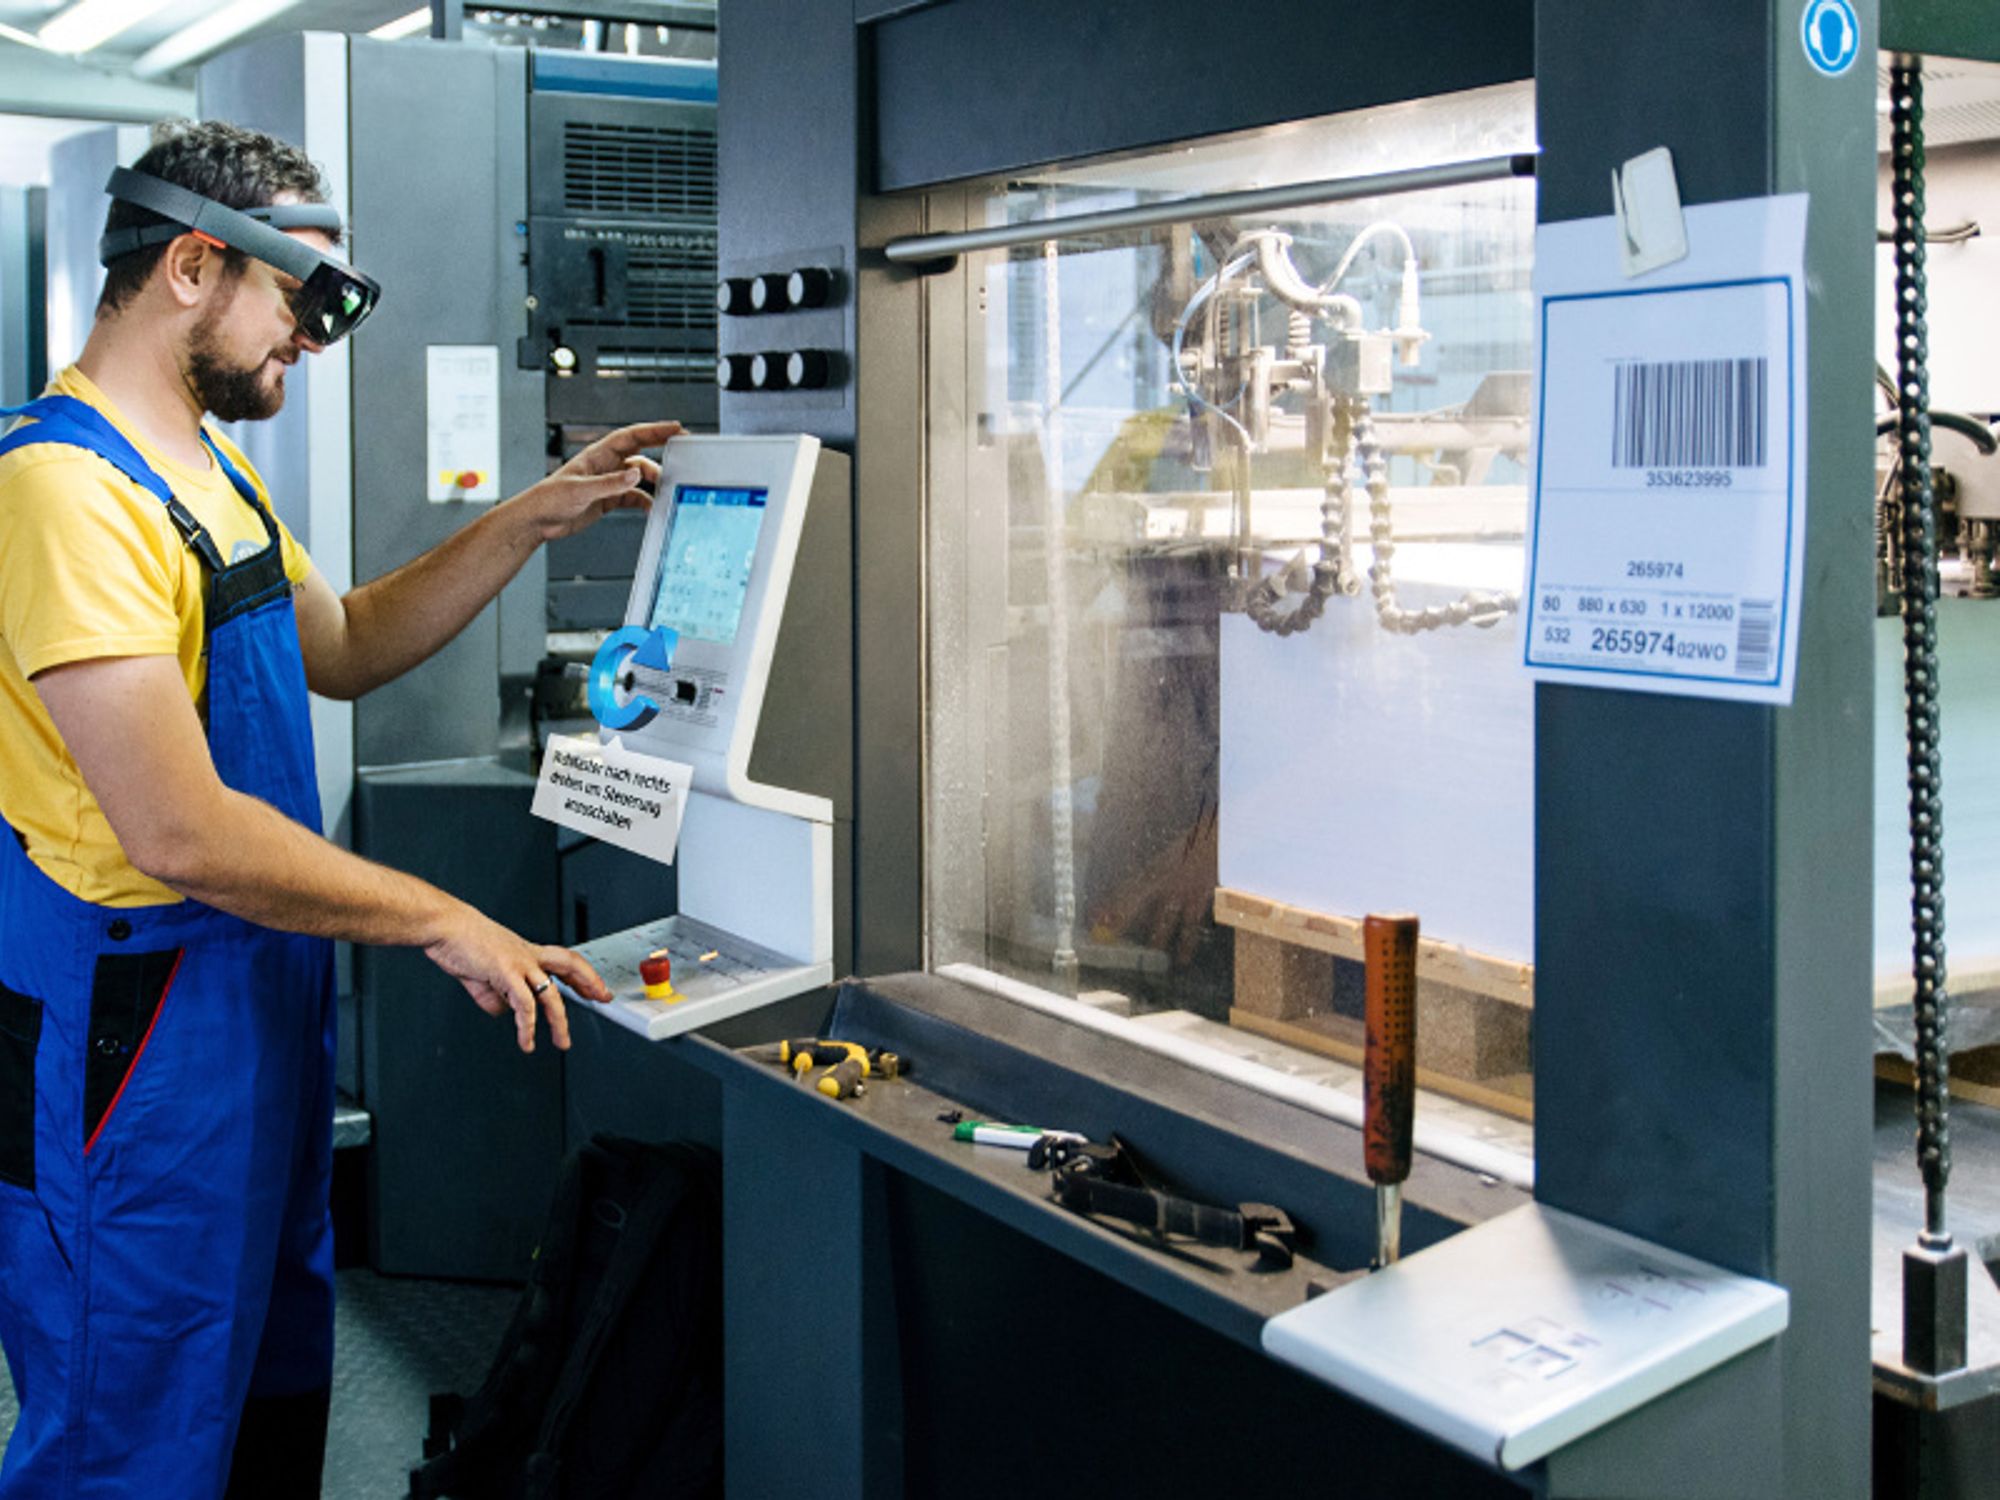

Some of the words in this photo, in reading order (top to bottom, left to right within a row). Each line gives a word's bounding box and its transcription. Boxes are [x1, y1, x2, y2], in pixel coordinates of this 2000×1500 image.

[1646, 470, 1733, 488] 353623995
[1627, 560, 1684, 578] 265974
[1661, 600, 1670, 617] 1
[1689, 603, 1735, 622] 12000
[1544, 626, 1572, 645] 532
